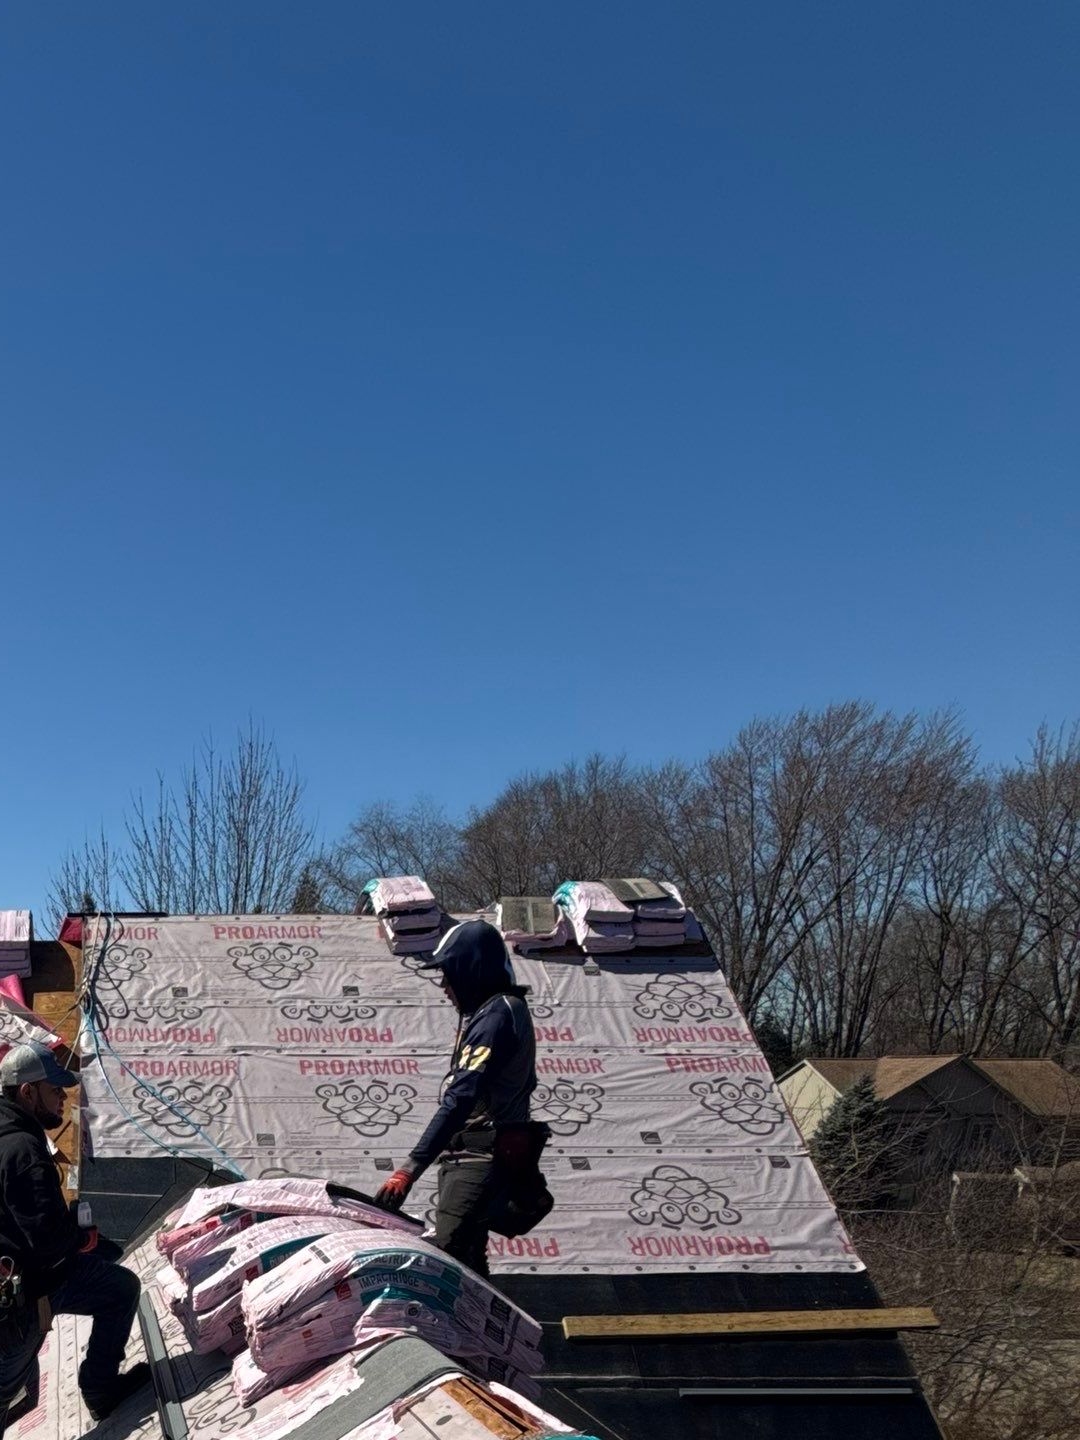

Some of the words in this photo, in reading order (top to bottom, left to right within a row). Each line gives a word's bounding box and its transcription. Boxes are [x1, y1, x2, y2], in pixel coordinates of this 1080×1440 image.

[214, 924, 323, 940] PROARMOR
[276, 1027, 394, 1044] PROARMOR
[120, 1059, 239, 1076] PROARMOR
[299, 1058, 420, 1075] PROARMOR
[627, 1236, 771, 1257] PROARMOR
[360, 1272, 420, 1290] IMPACTRIDGE
